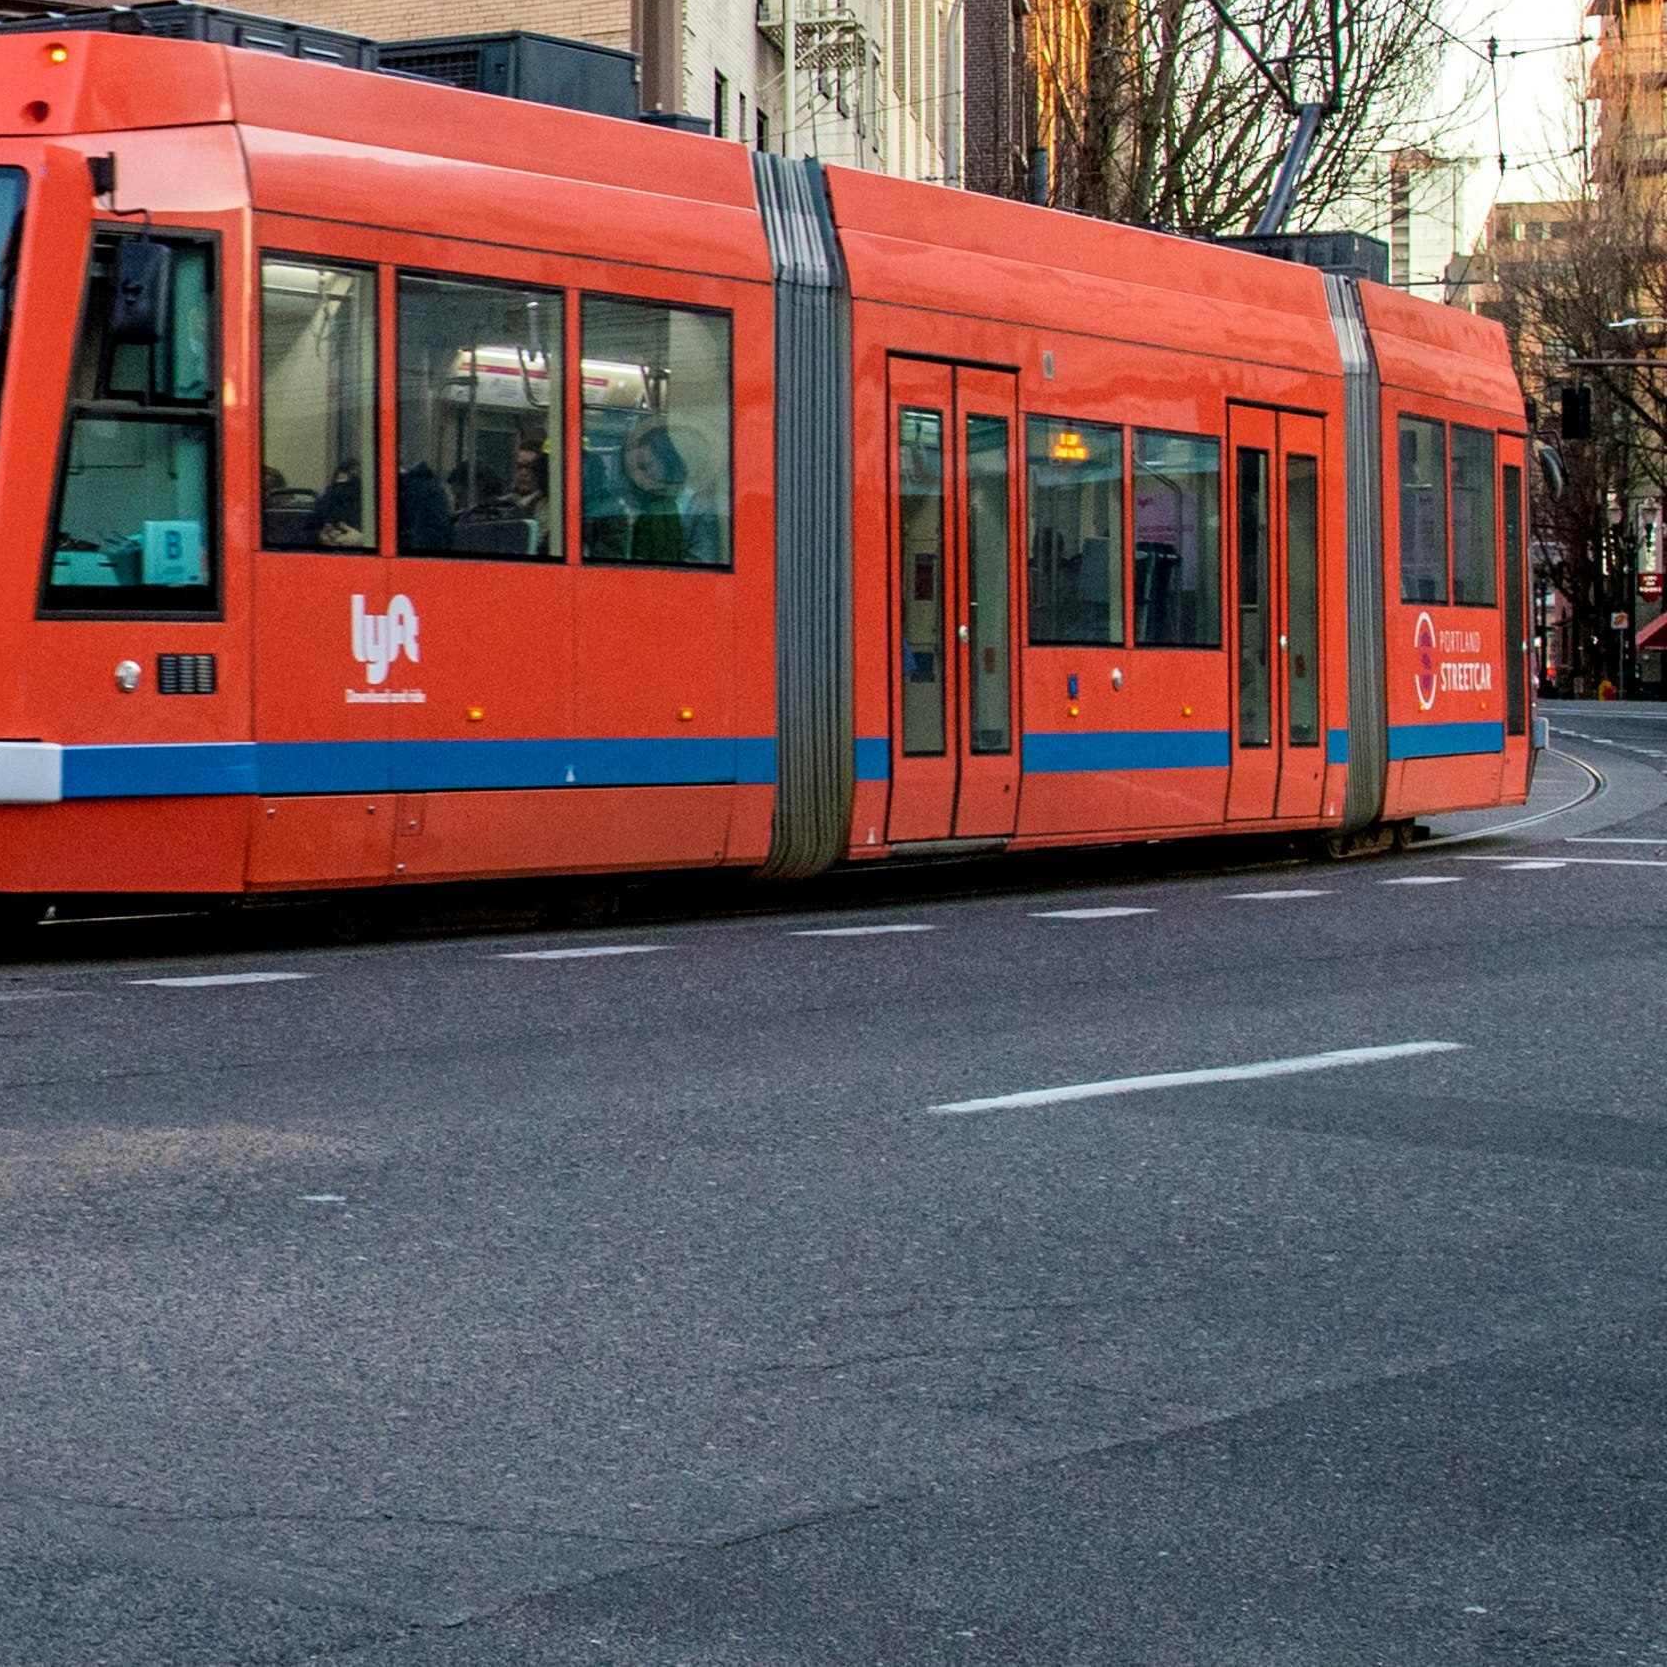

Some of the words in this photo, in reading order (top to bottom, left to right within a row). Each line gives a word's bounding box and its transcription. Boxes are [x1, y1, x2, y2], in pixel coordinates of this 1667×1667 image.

[351, 594, 420, 684] lyft
[1440, 630, 1481, 653] PORTLAND
[1440, 662, 1492, 692] STREETCAR
